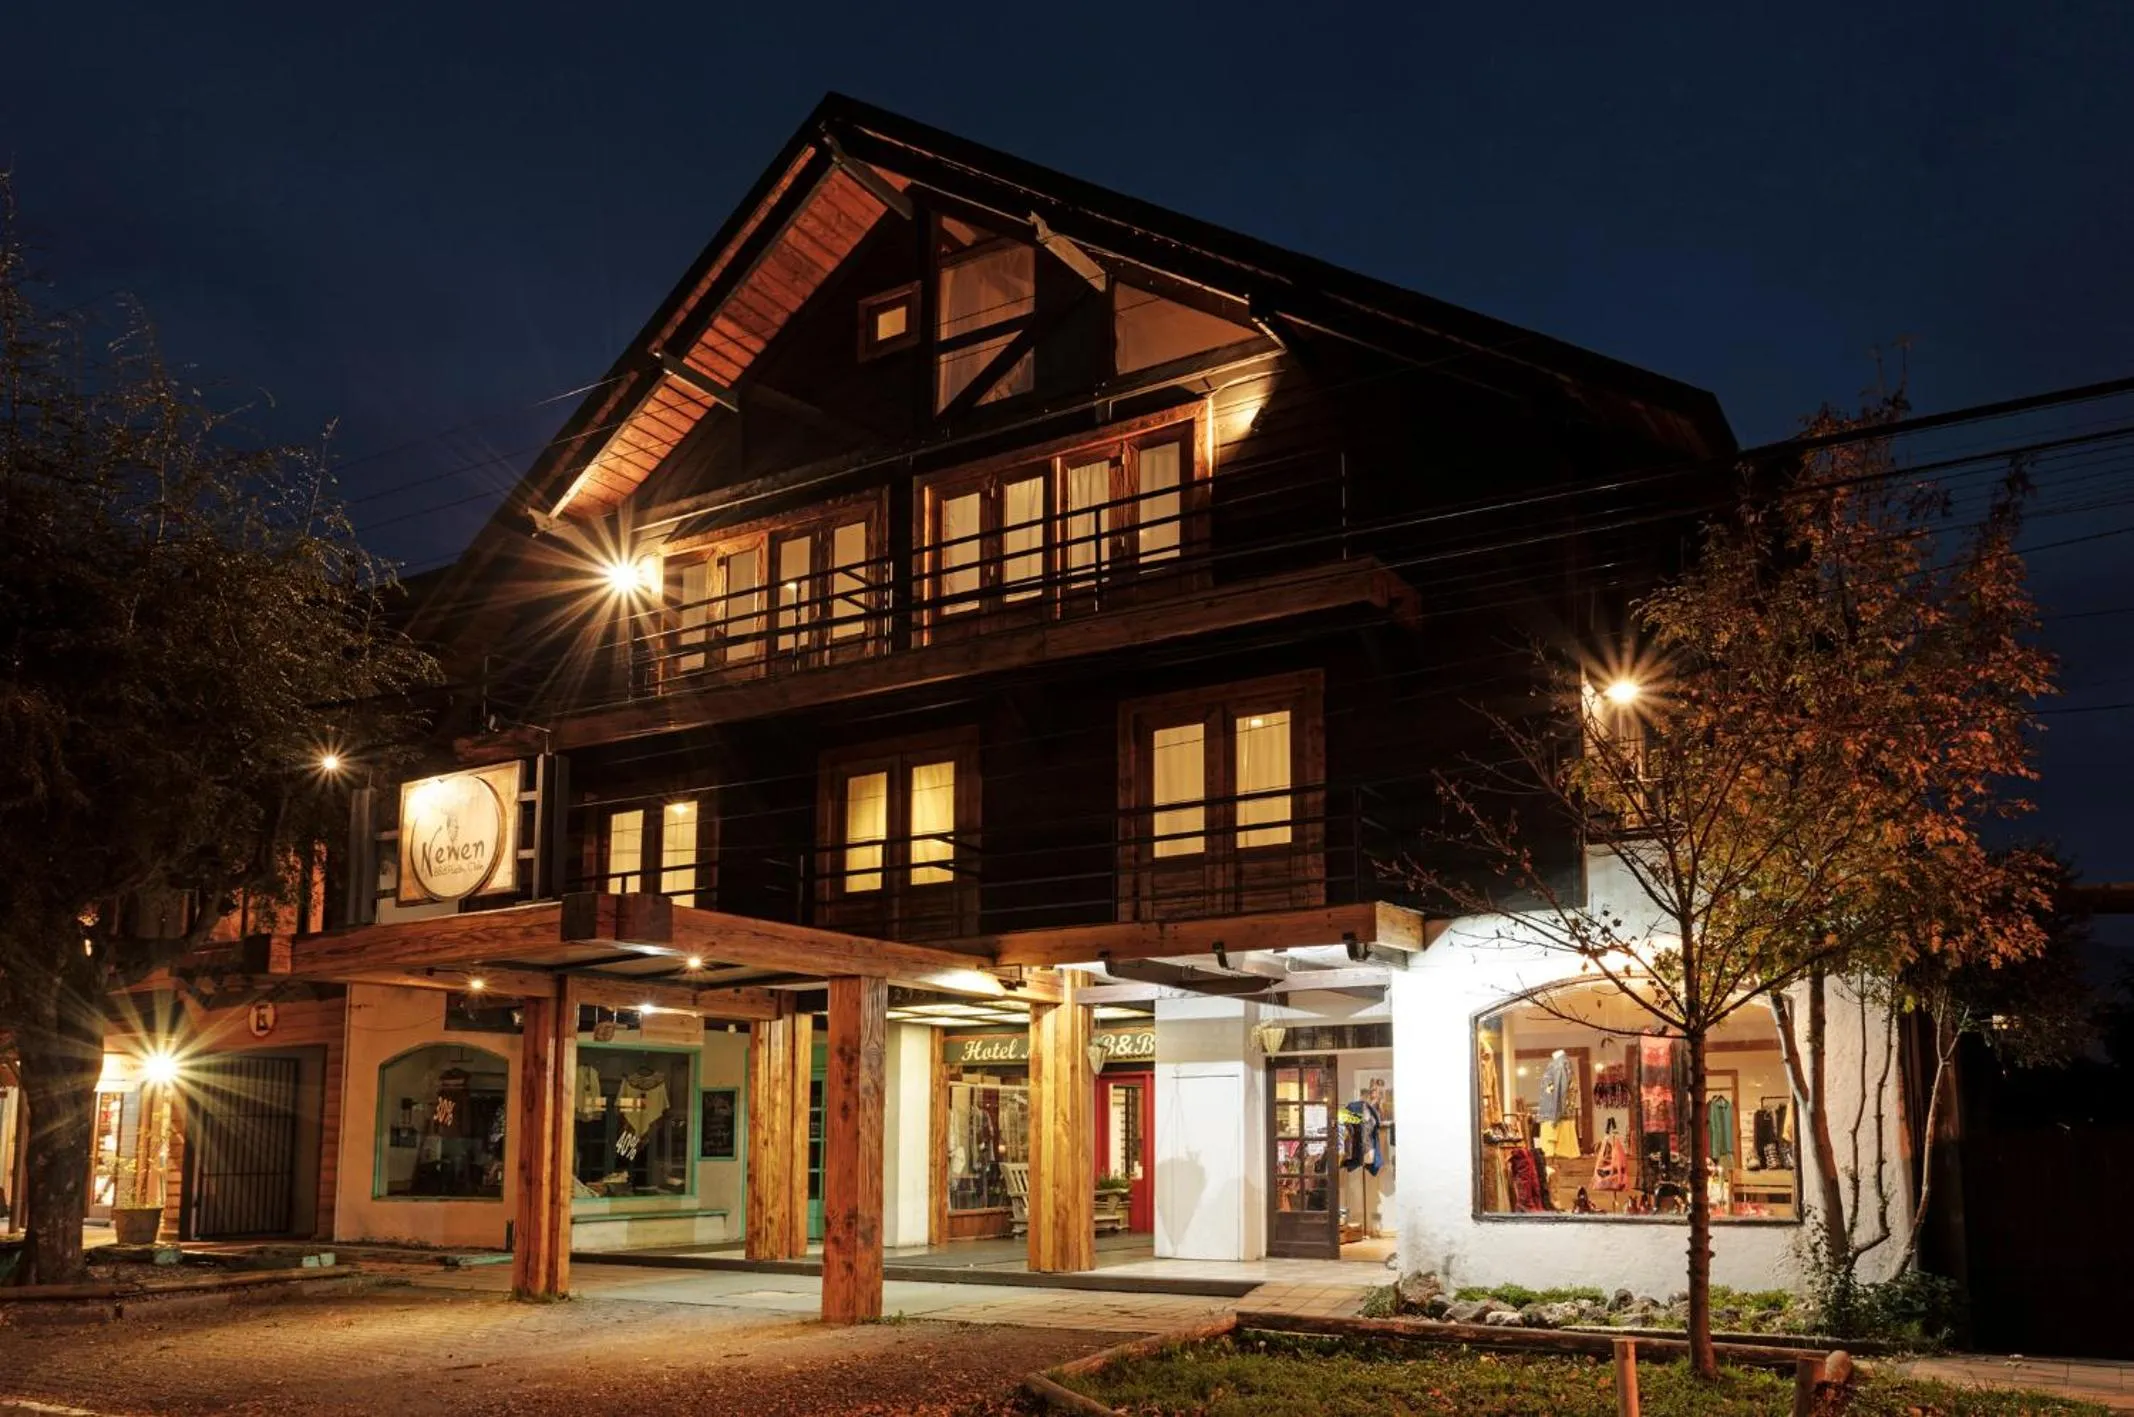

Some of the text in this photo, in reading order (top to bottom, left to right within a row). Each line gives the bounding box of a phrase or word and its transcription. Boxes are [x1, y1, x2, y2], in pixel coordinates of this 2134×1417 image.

[421, 825, 485, 878] Newen
[961, 1038, 1018, 1061] Hotel
[1100, 1032, 1155, 1056] B&B
[615, 1130, 640, 1162] 40%
